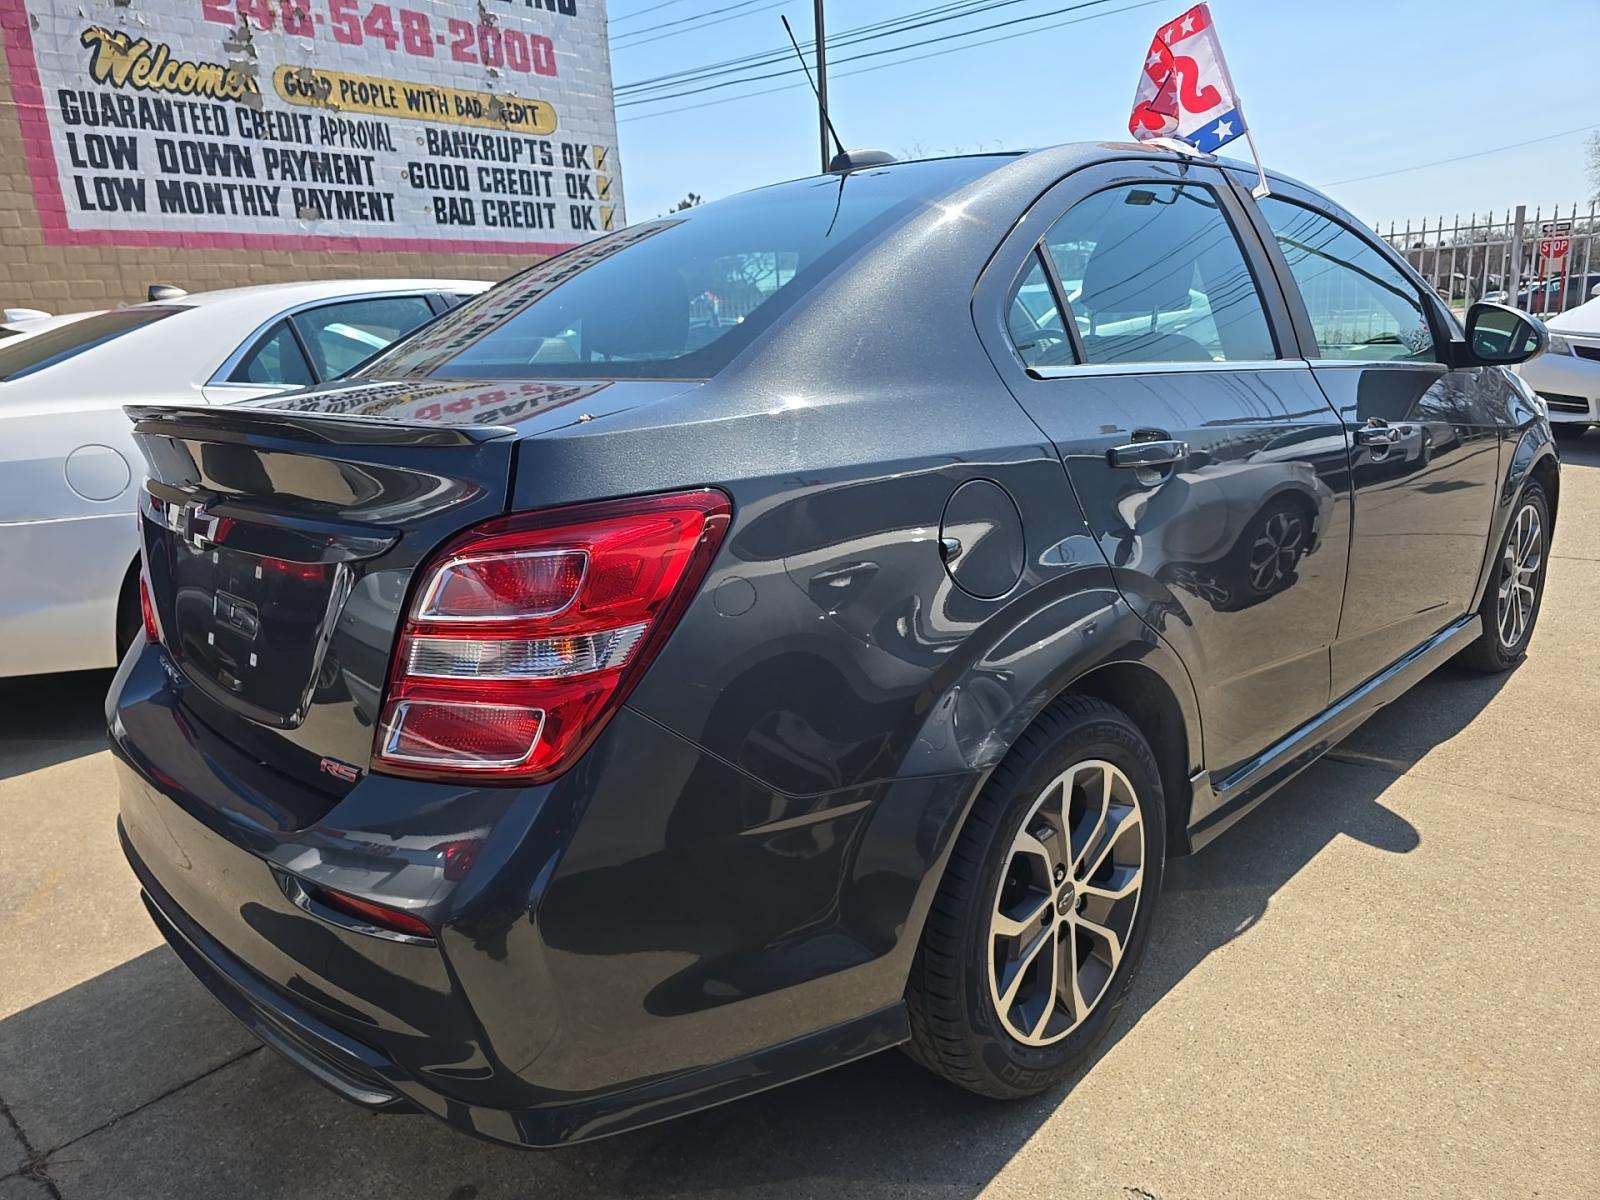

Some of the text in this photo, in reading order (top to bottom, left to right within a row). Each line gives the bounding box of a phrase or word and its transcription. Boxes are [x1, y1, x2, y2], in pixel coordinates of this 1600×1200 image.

[81, 25, 245, 101] Welcome
[57, 89, 397, 152] GUARANTEED CREDIT APPROVAL
[340, 81, 399, 109] PEOPLE
[404, 87, 448, 116] WITH
[454, 94, 482, 119] BAD
[65, 132, 375, 187] LOW DOWN PAYMENT
[425, 128, 591, 170] BANKRUPTS OK
[73, 175, 396, 222] LOW MONTHLY PAYMENT
[408, 161, 595, 201] GOOD CREDIT OK
[432, 195, 597, 231] BAD CREDIT OK
[1542, 240, 1568, 252] SOP
[320, 758, 358, 783] RS
